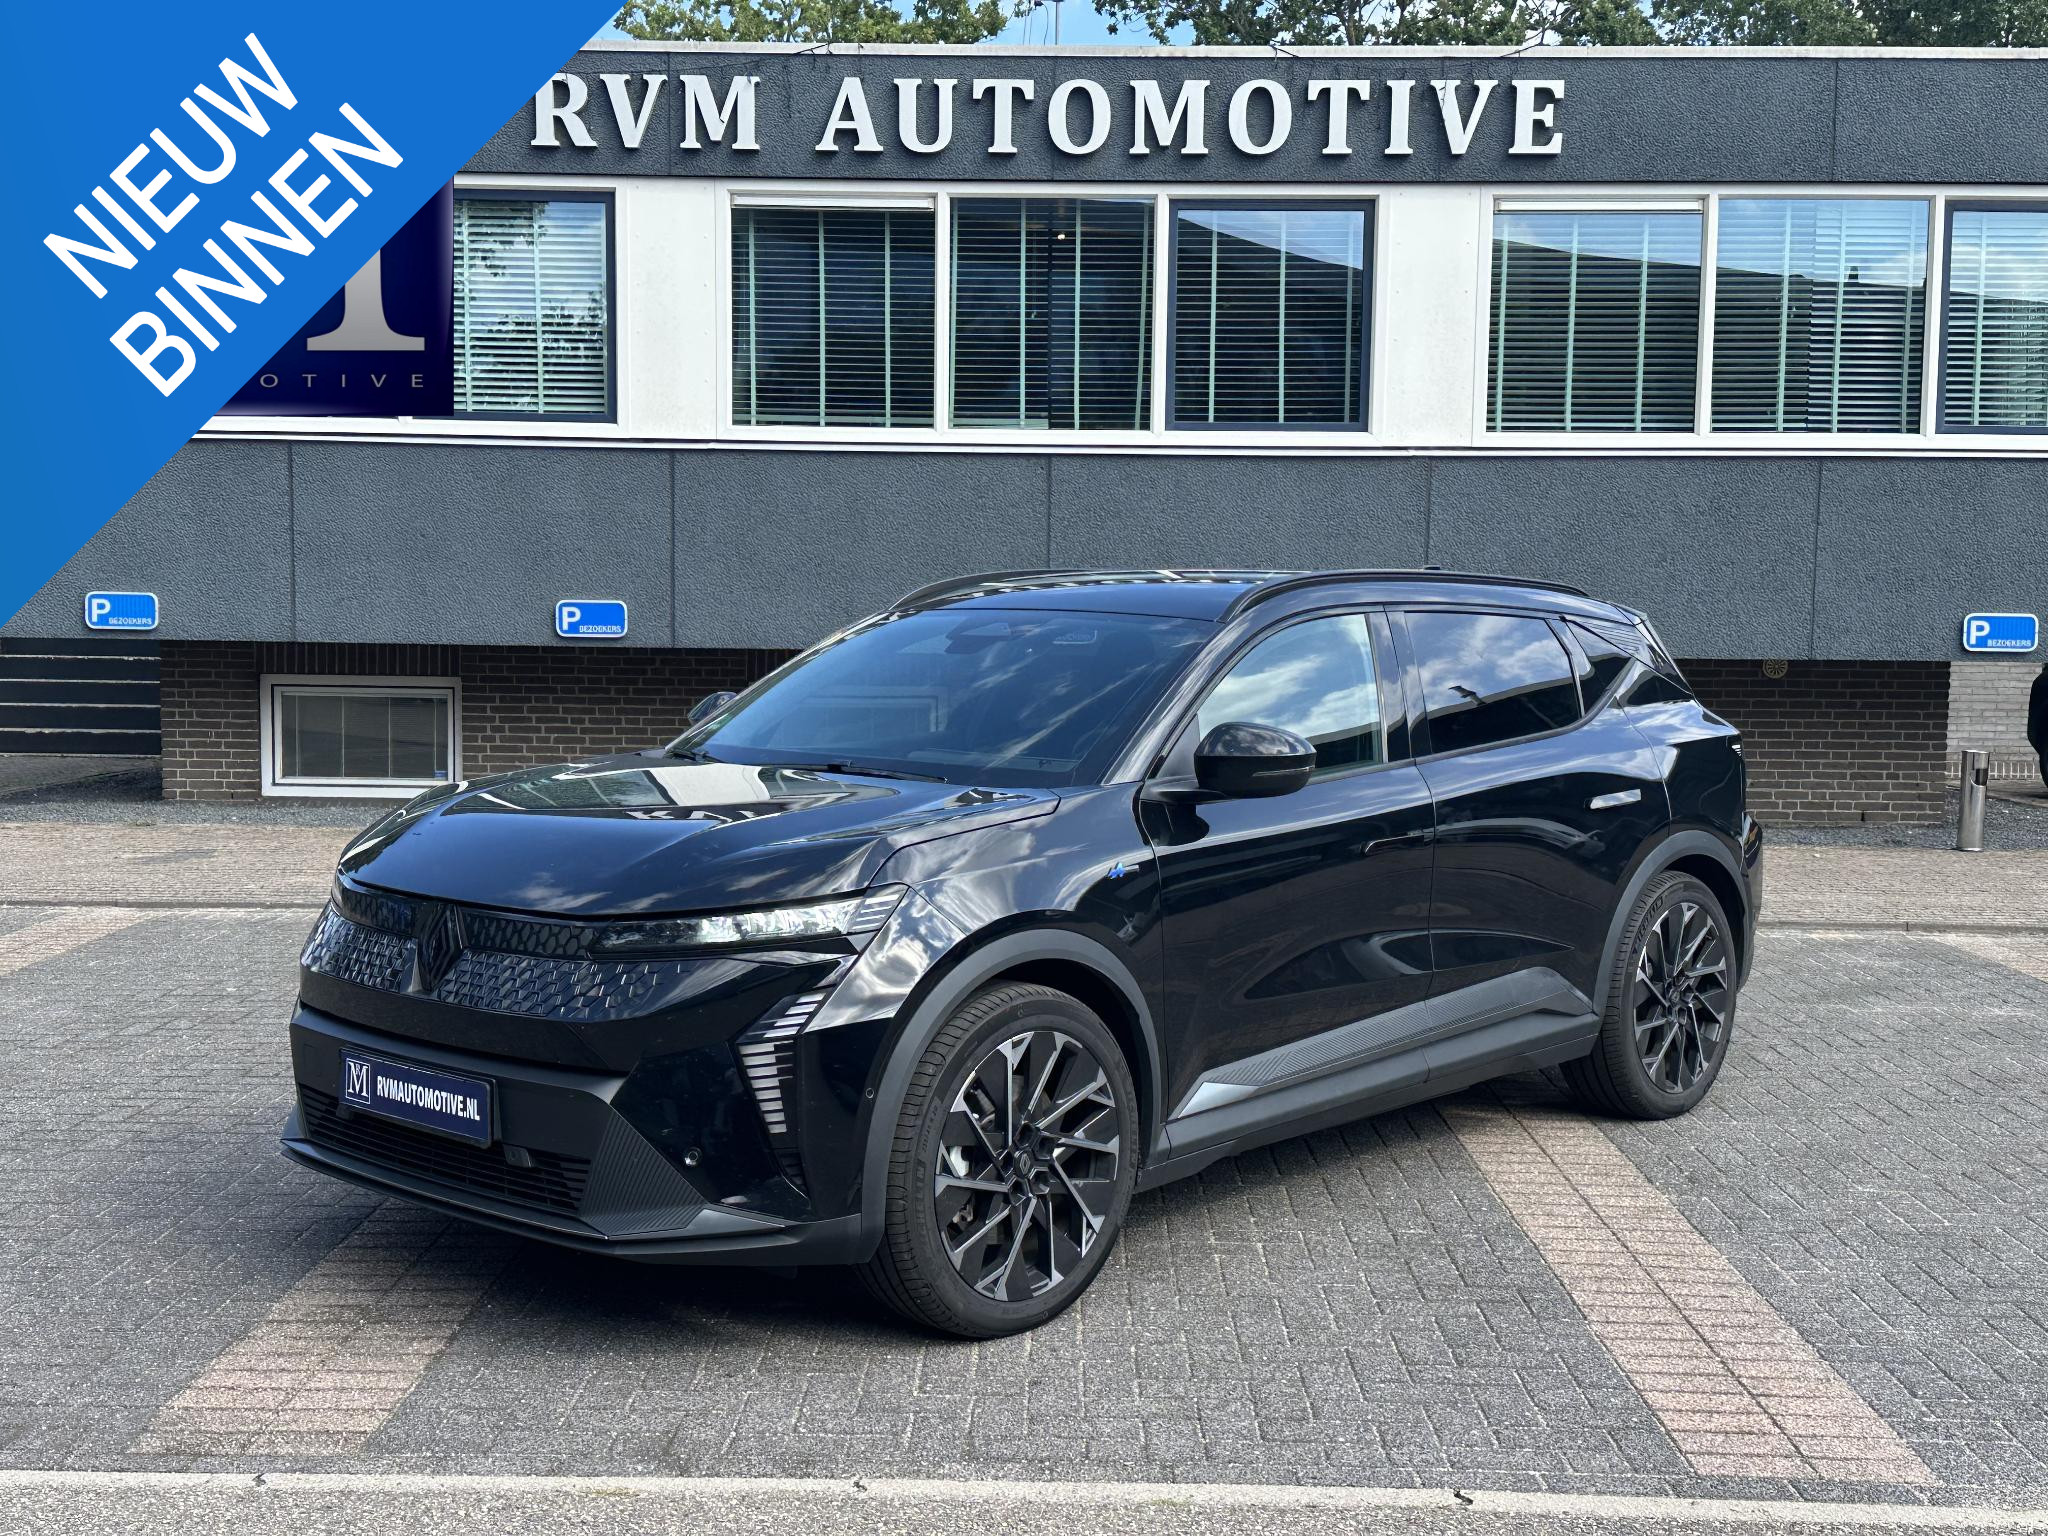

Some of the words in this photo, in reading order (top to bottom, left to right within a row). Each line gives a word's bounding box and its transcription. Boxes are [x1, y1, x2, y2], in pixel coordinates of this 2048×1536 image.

[530, 72, 761, 151] RVM
[814, 76, 1566, 156] AUTOMOTIVE
[91, 598, 111, 622] P
[562, 606, 581, 631] P
[1969, 620, 1990, 645] P
[377, 1075, 480, 1121] RVMAUTOMOTIVE.NL
